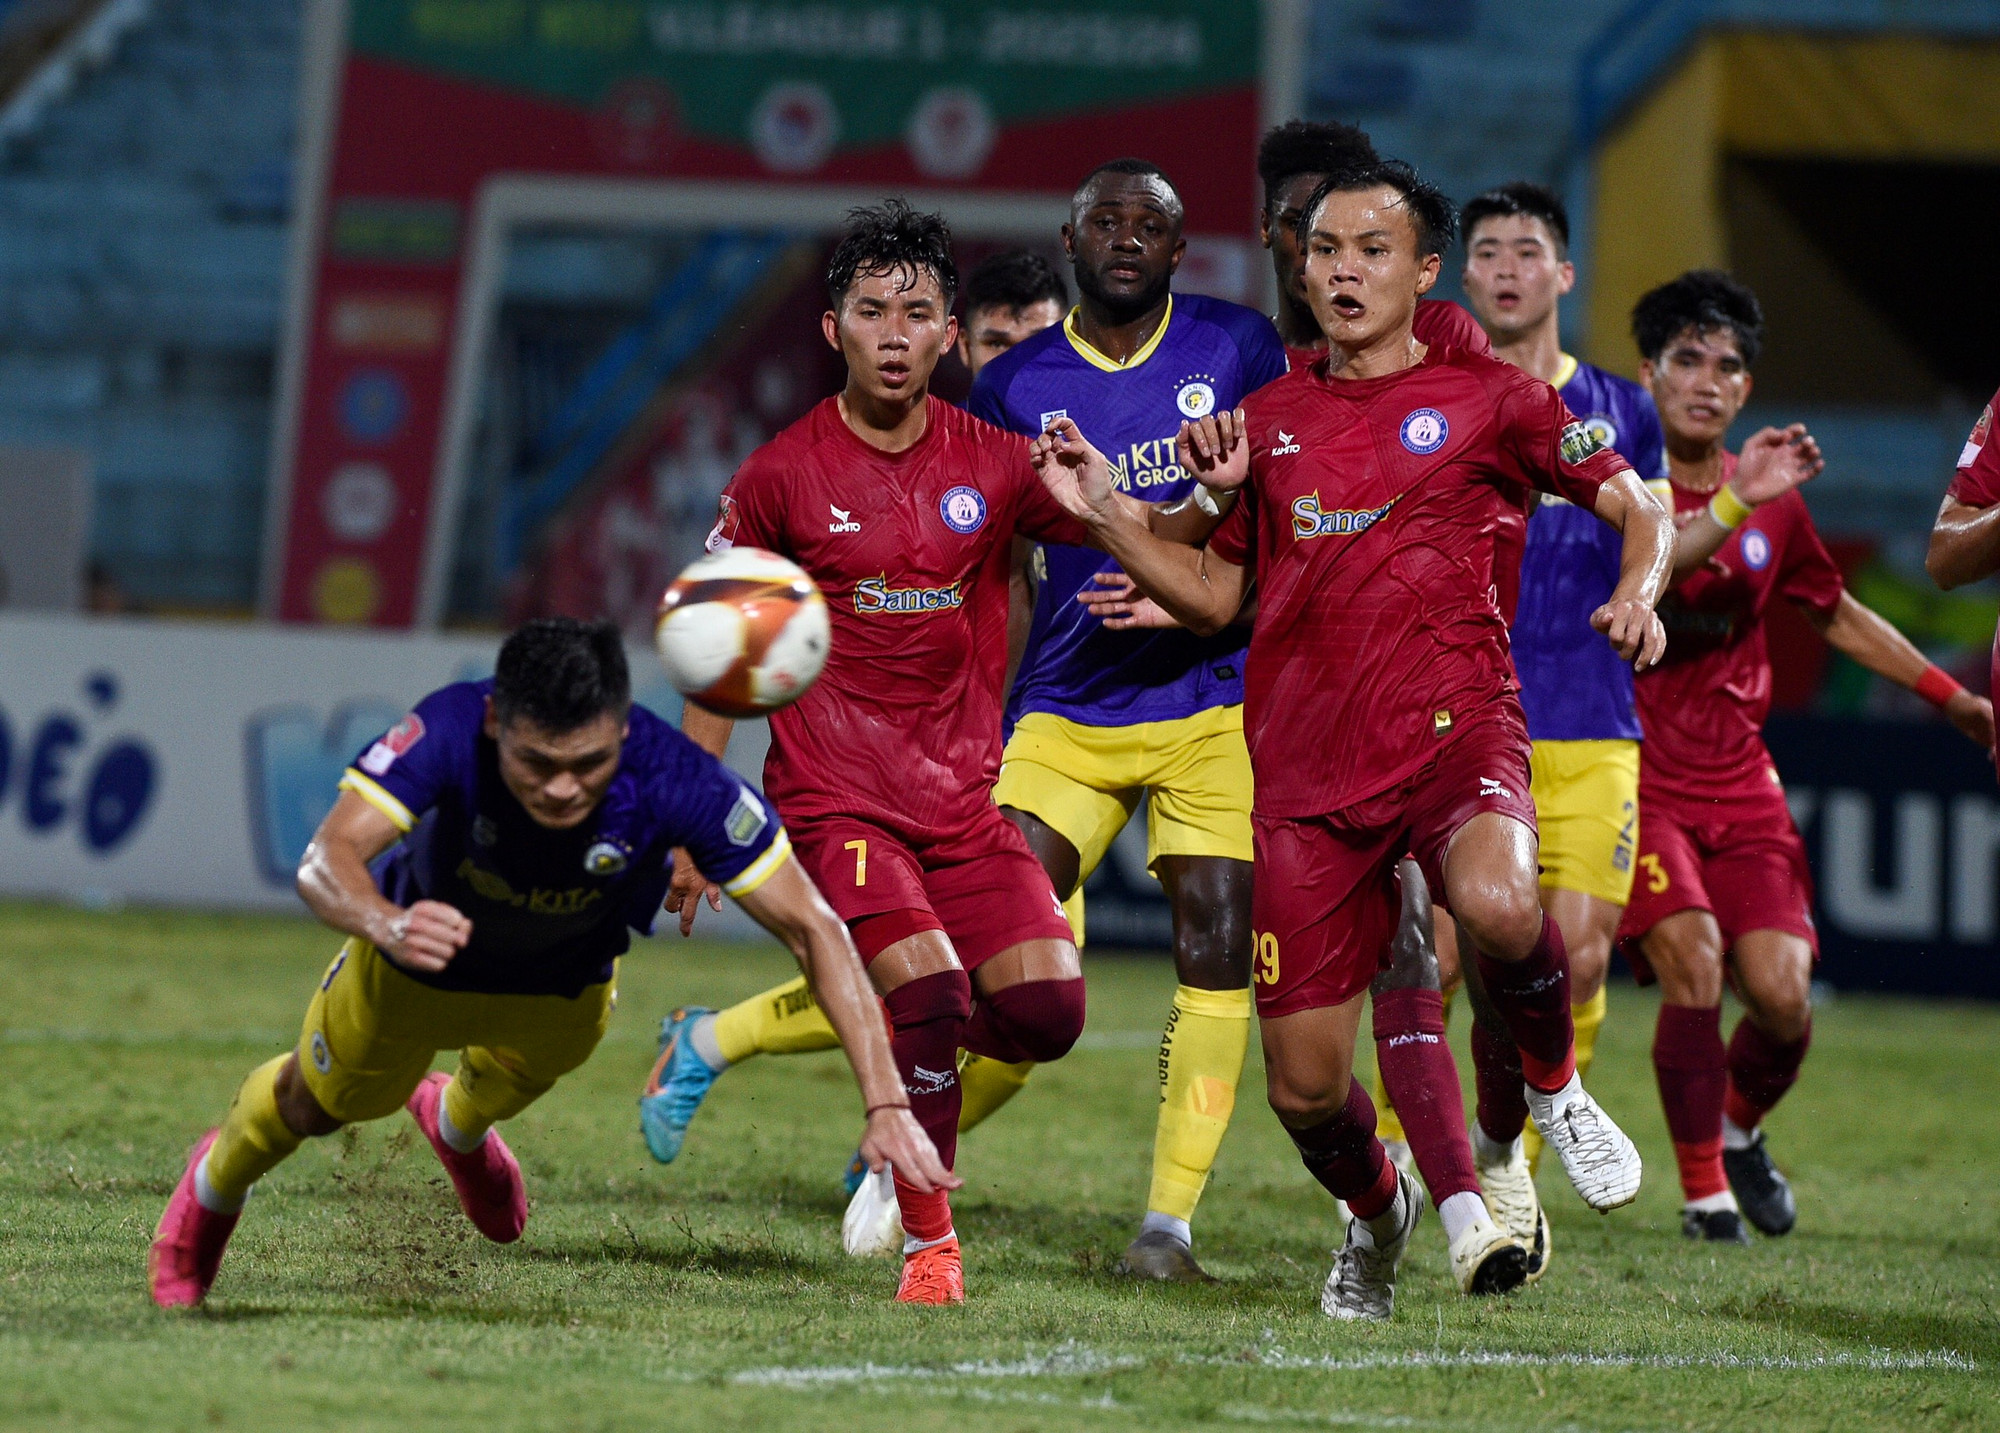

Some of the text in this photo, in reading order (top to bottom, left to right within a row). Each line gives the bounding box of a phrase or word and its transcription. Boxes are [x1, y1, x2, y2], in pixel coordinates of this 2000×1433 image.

[1131, 436, 1177, 470] KIT
[1272, 444, 1301, 456] KAMITO
[1136, 465, 1192, 488] GROU
[1291, 488, 1400, 541] Sanes
[829, 522, 861, 533] KAMITO
[853, 570, 963, 613] Sanest
[1480, 787, 1511, 799] KAMITO
[844, 839, 867, 886] 7
[1389, 1032, 1439, 1049] KAMITO
